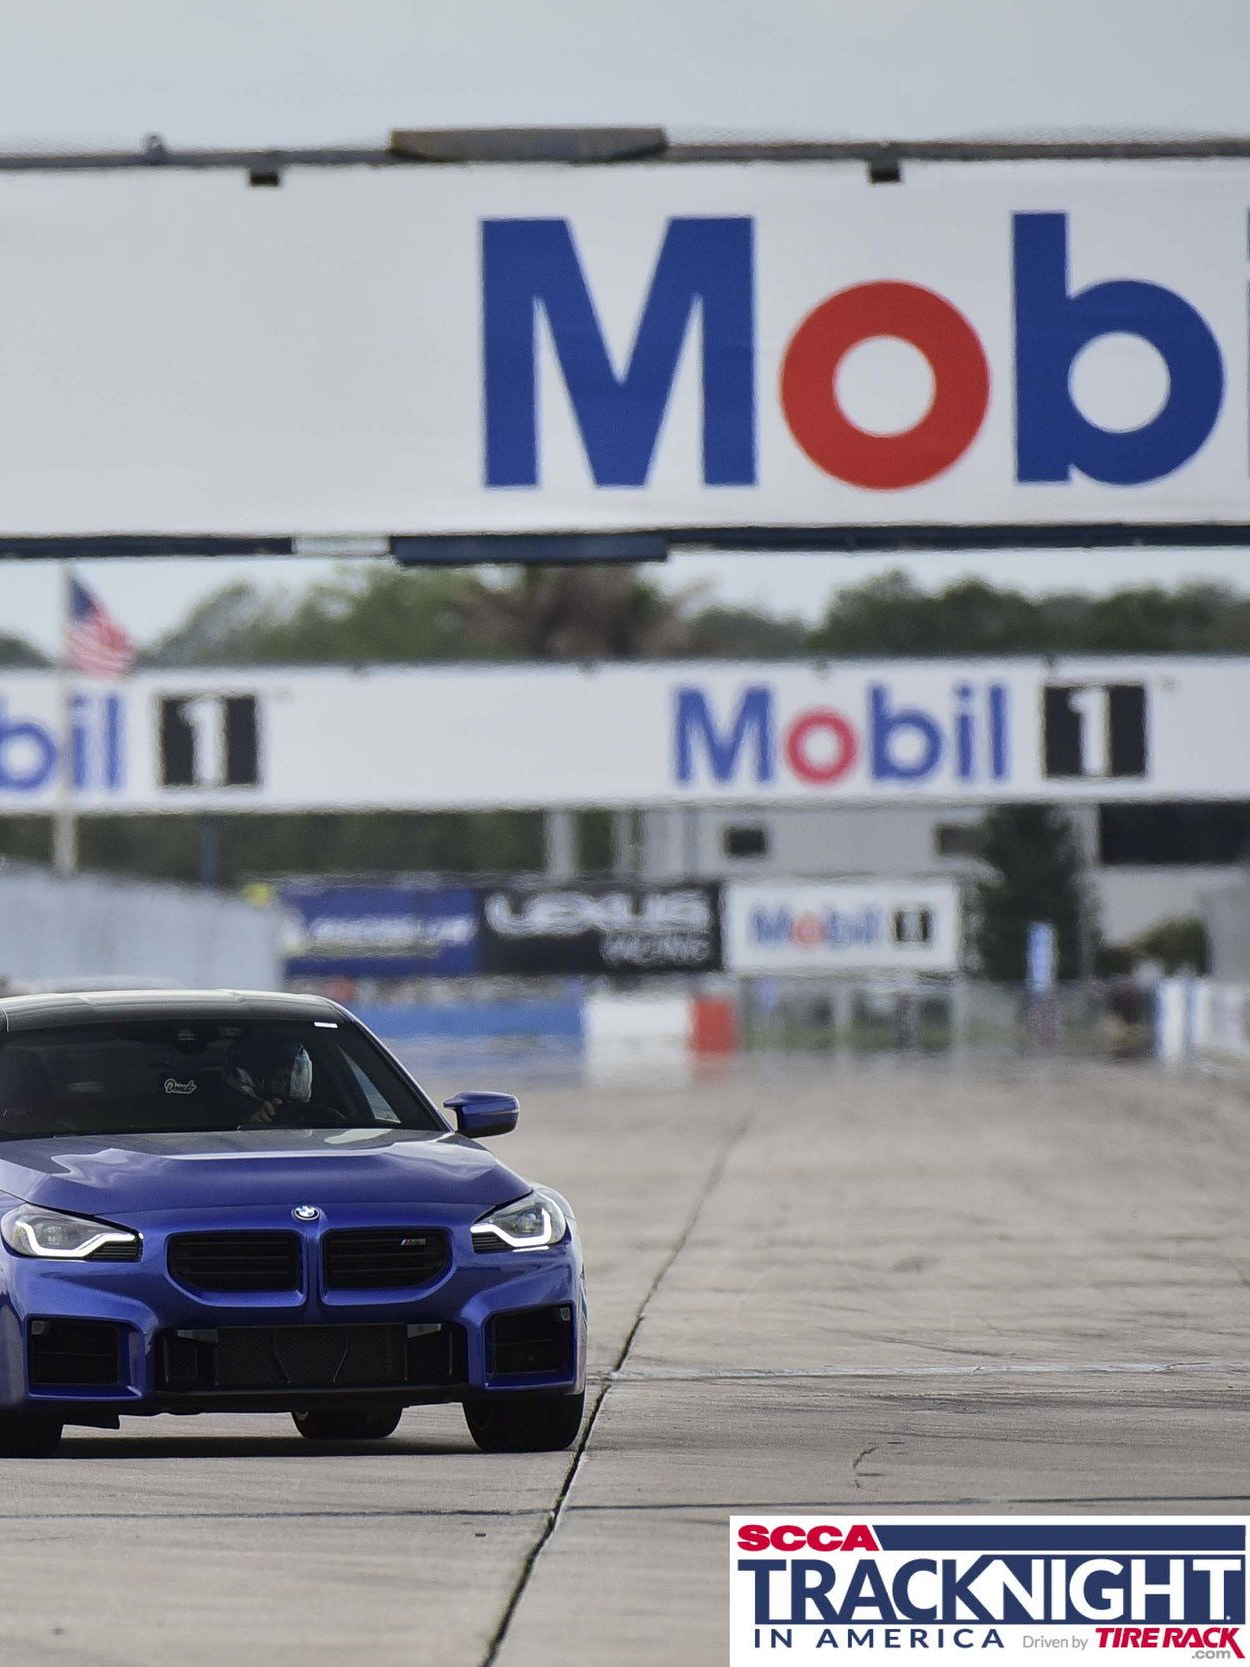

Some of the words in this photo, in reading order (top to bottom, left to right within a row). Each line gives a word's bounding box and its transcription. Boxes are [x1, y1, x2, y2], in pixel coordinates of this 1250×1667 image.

[480, 211, 1250, 493] Mob
[672, 683, 1008, 786] Mobil
[753, 905, 880, 950] Mobil
